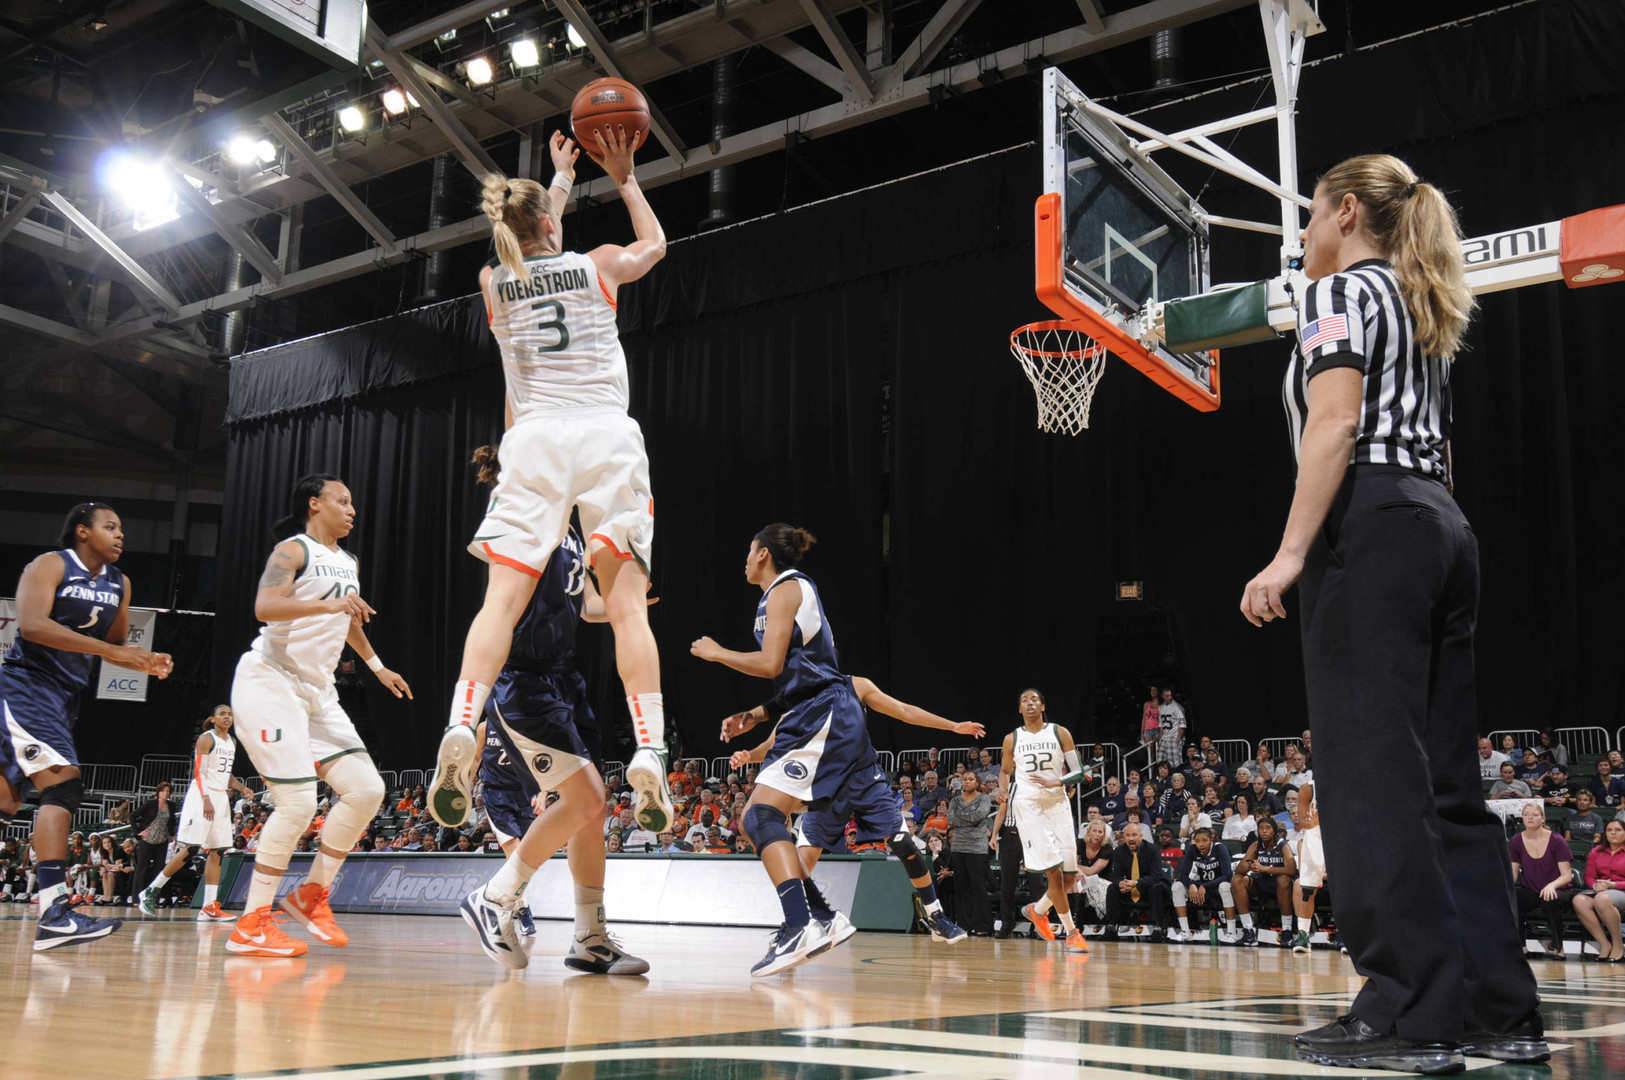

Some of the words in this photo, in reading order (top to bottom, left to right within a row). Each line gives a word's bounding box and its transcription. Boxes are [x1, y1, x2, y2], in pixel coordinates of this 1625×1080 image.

[530, 264, 551, 276] ACC
[531, 300, 570, 353] 3
[60, 585, 96, 601] PENN
[78, 605, 104, 628] 5
[107, 678, 139, 691] ACC
[261, 729, 282, 743] U
[1023, 752, 1054, 773] 32
[370, 866, 481, 901] Aaron's
[1203, 870, 1215, 881] 20
